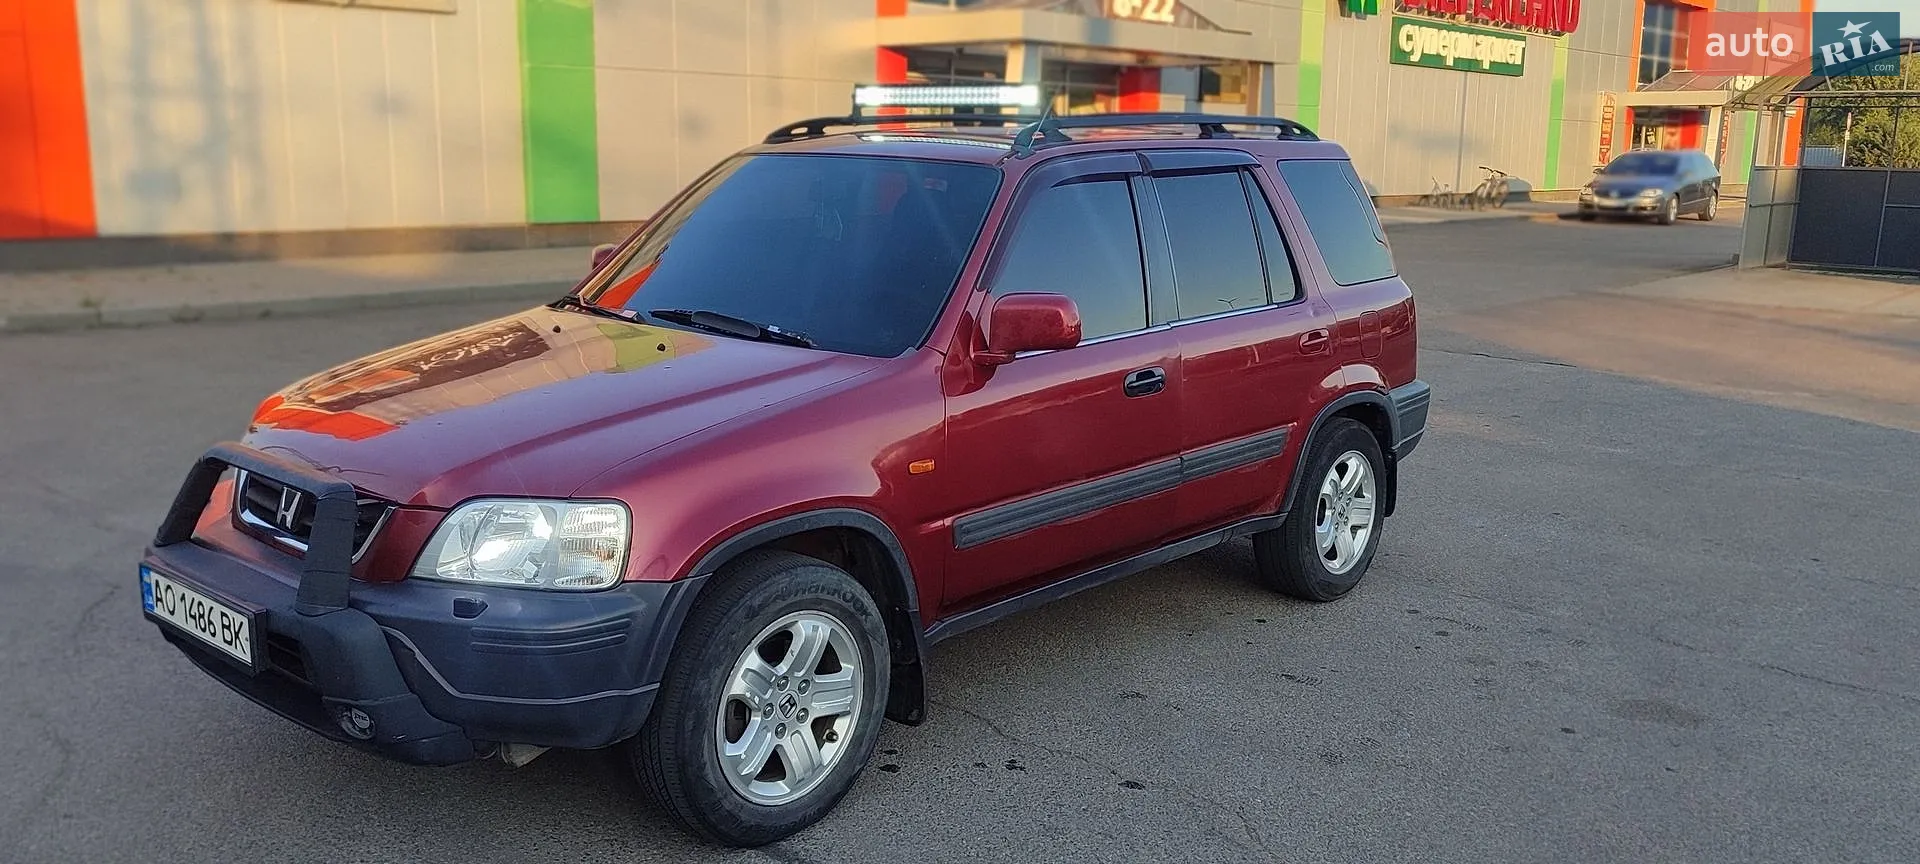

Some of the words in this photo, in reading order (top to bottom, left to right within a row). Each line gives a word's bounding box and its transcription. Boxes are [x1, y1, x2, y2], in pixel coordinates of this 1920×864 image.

[1399, 23, 1526, 69] супермаркет
[154, 578, 176, 617] AO
[179, 592, 217, 639] 1486
[220, 610, 247, 655] BK
